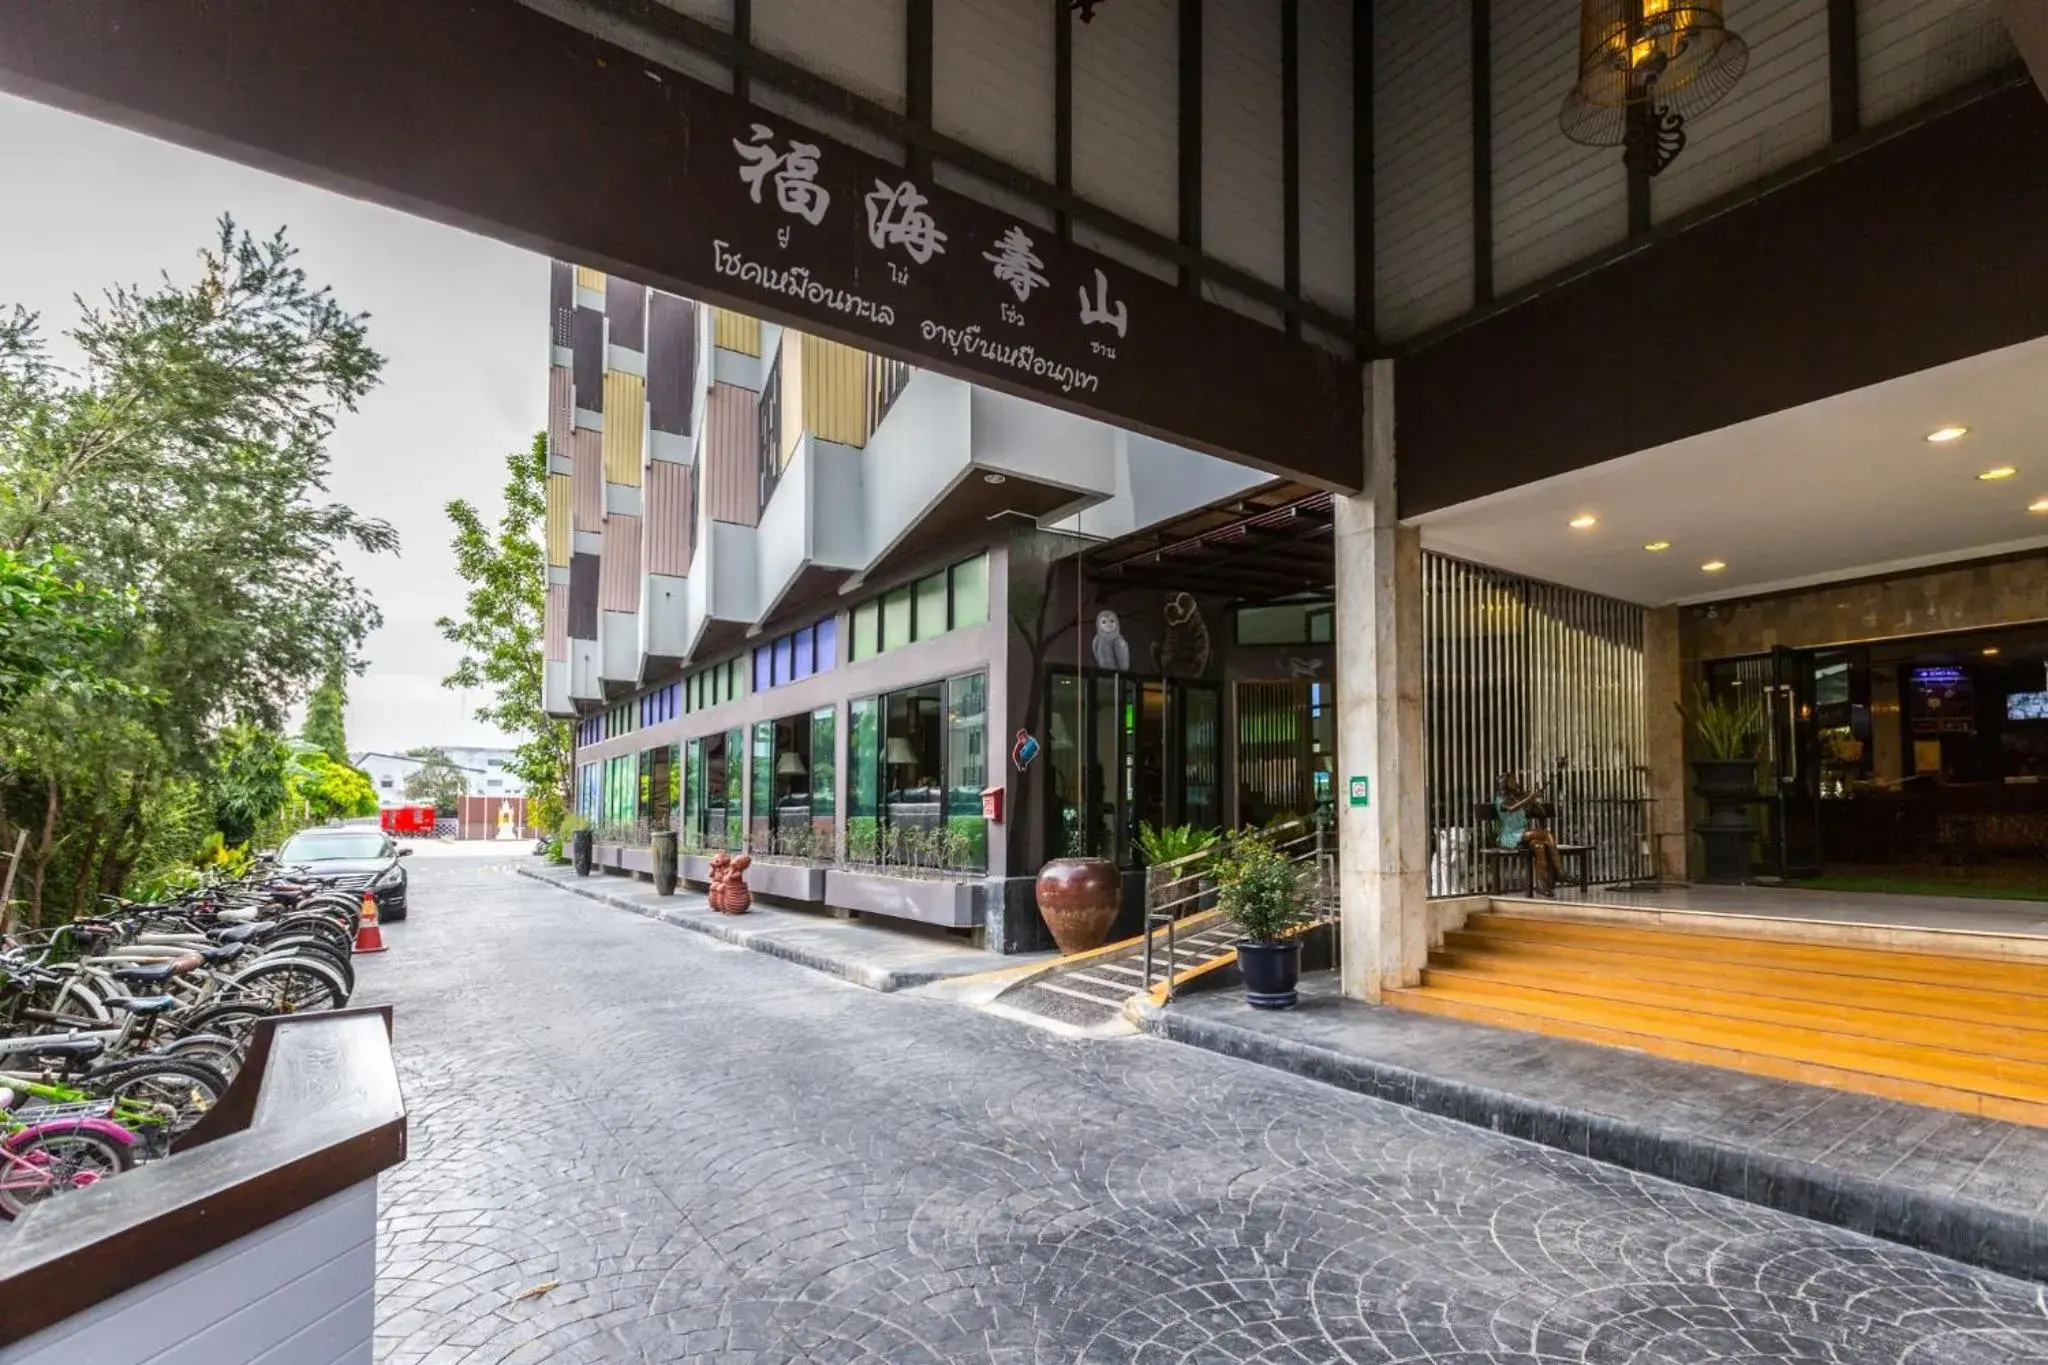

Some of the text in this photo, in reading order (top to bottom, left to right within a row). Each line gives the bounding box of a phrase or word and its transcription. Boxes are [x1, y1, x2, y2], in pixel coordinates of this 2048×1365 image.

[712, 239, 1099, 393] โชคเหมือนทะเล อายุยืนเหมือนภูเขา
